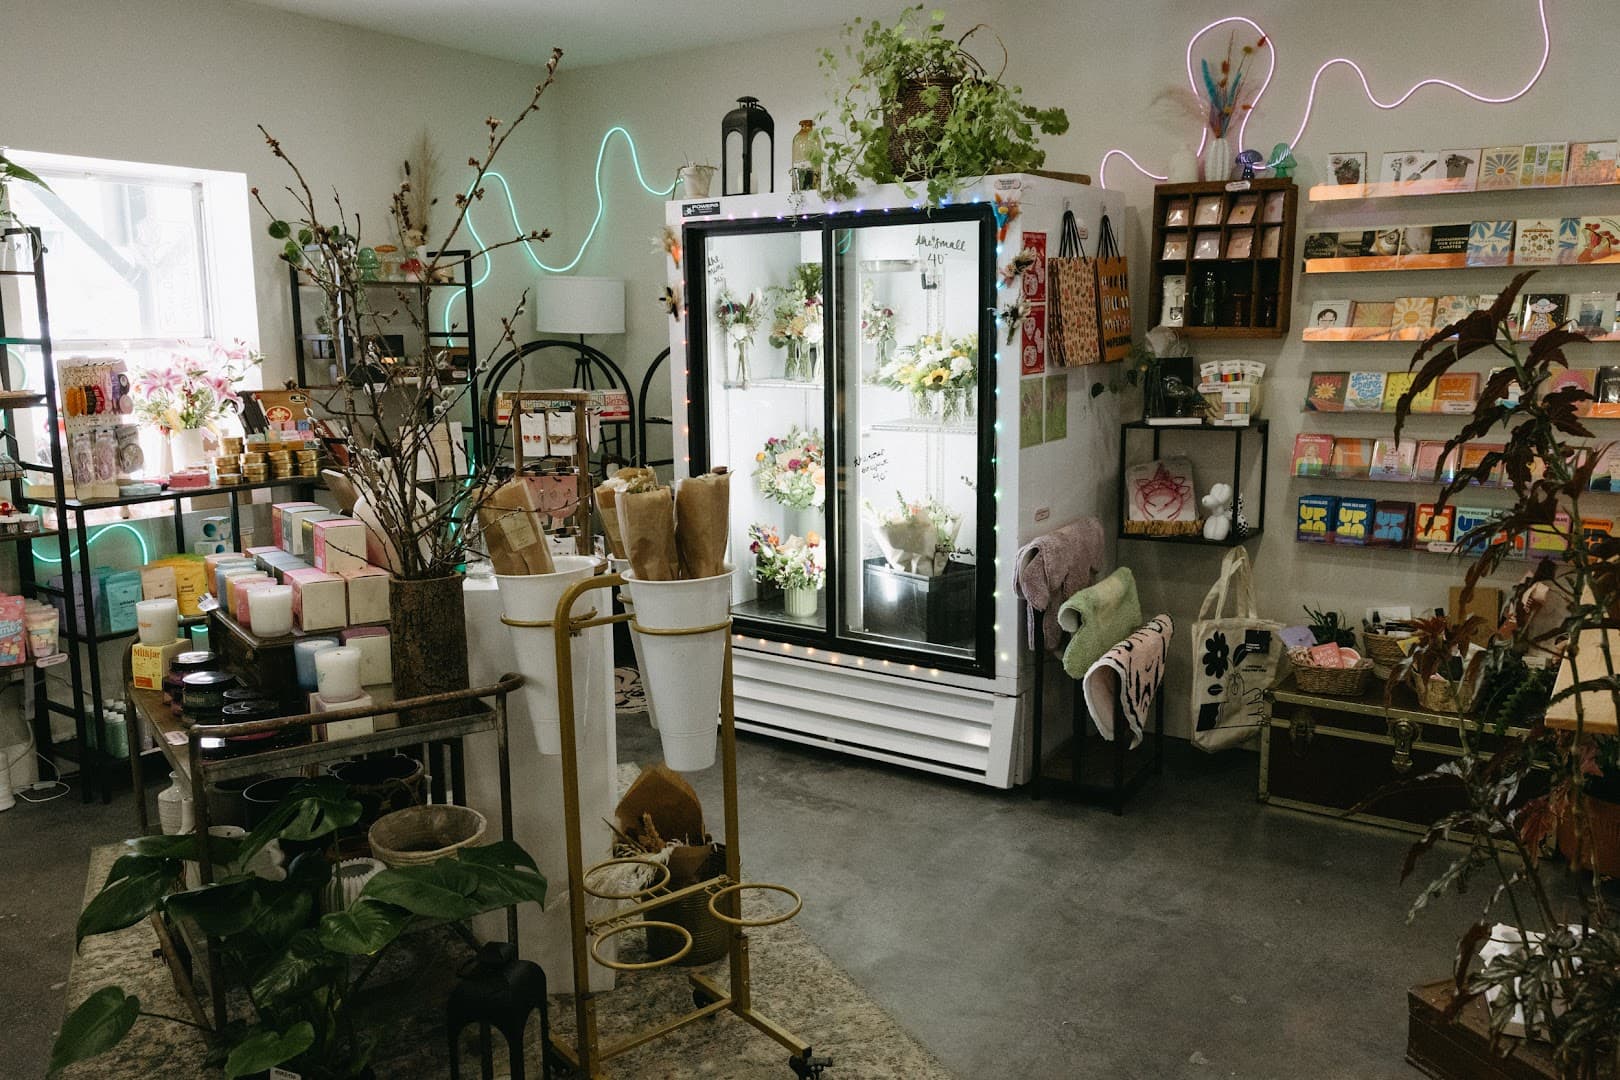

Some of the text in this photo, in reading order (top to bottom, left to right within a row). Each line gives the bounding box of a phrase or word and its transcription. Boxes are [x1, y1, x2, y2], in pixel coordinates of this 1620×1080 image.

[1300, 504, 1327, 520] UP
[1339, 507, 1367, 523] UP
[1376, 511, 1405, 526] UP
[133, 648, 161, 660] Milkjar
